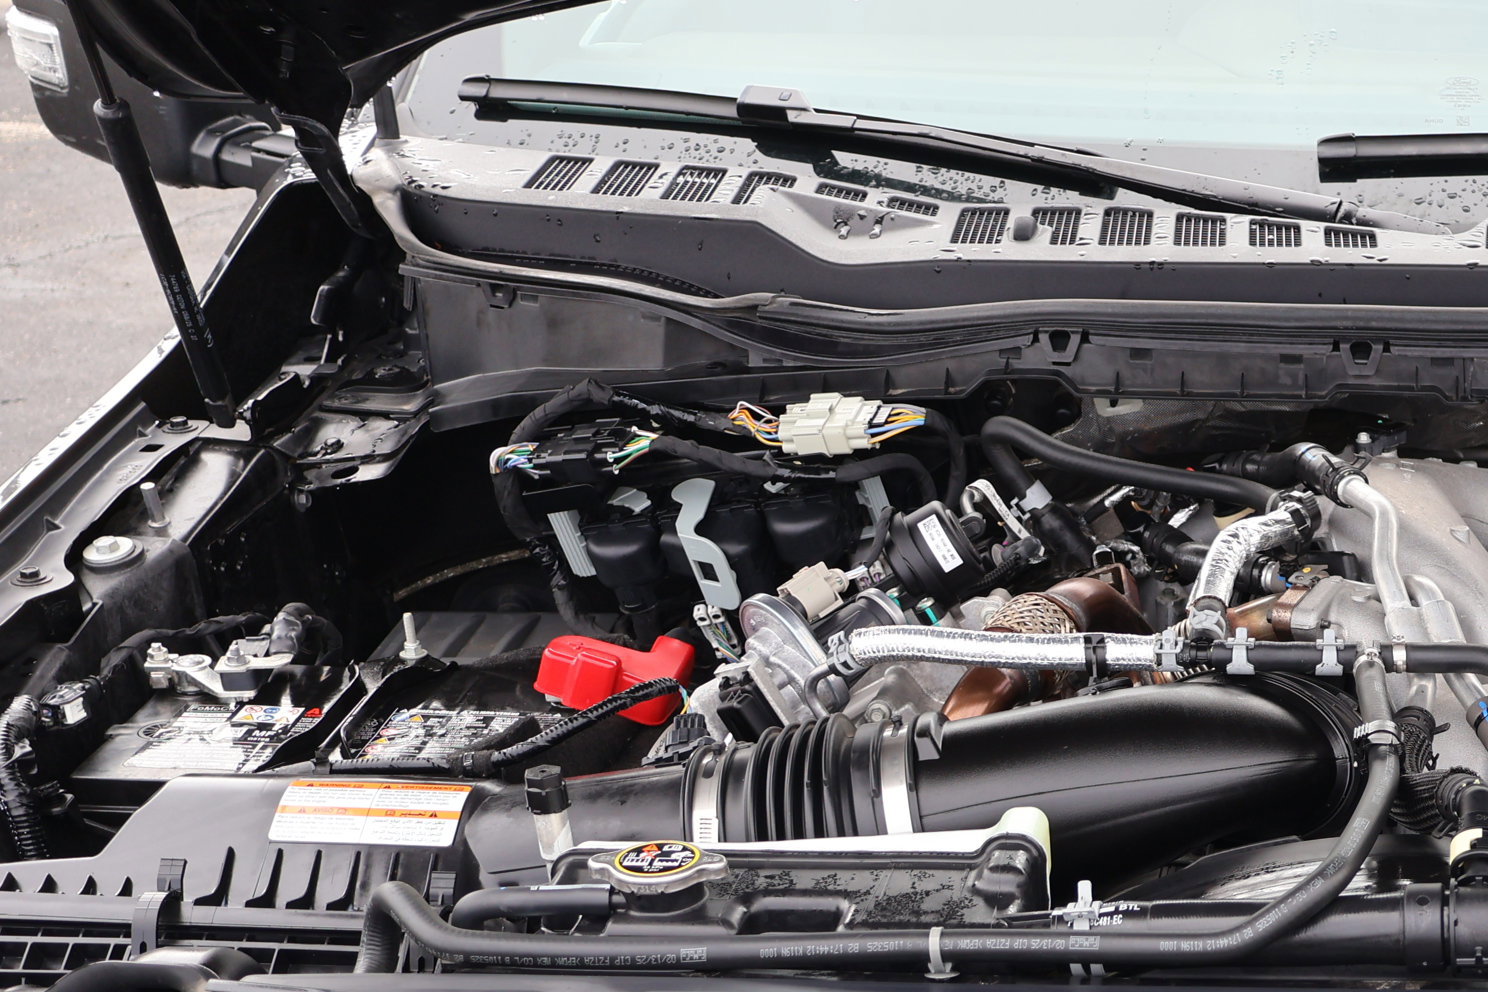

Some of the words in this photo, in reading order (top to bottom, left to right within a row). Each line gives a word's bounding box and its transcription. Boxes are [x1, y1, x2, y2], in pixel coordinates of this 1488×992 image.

[1119, 903, 1141, 911] BTL
[1206, 934, 1241, 951] 17:44:12
[760, 948, 777, 958] 1000
[807, 945, 843, 956] 17:44:12
